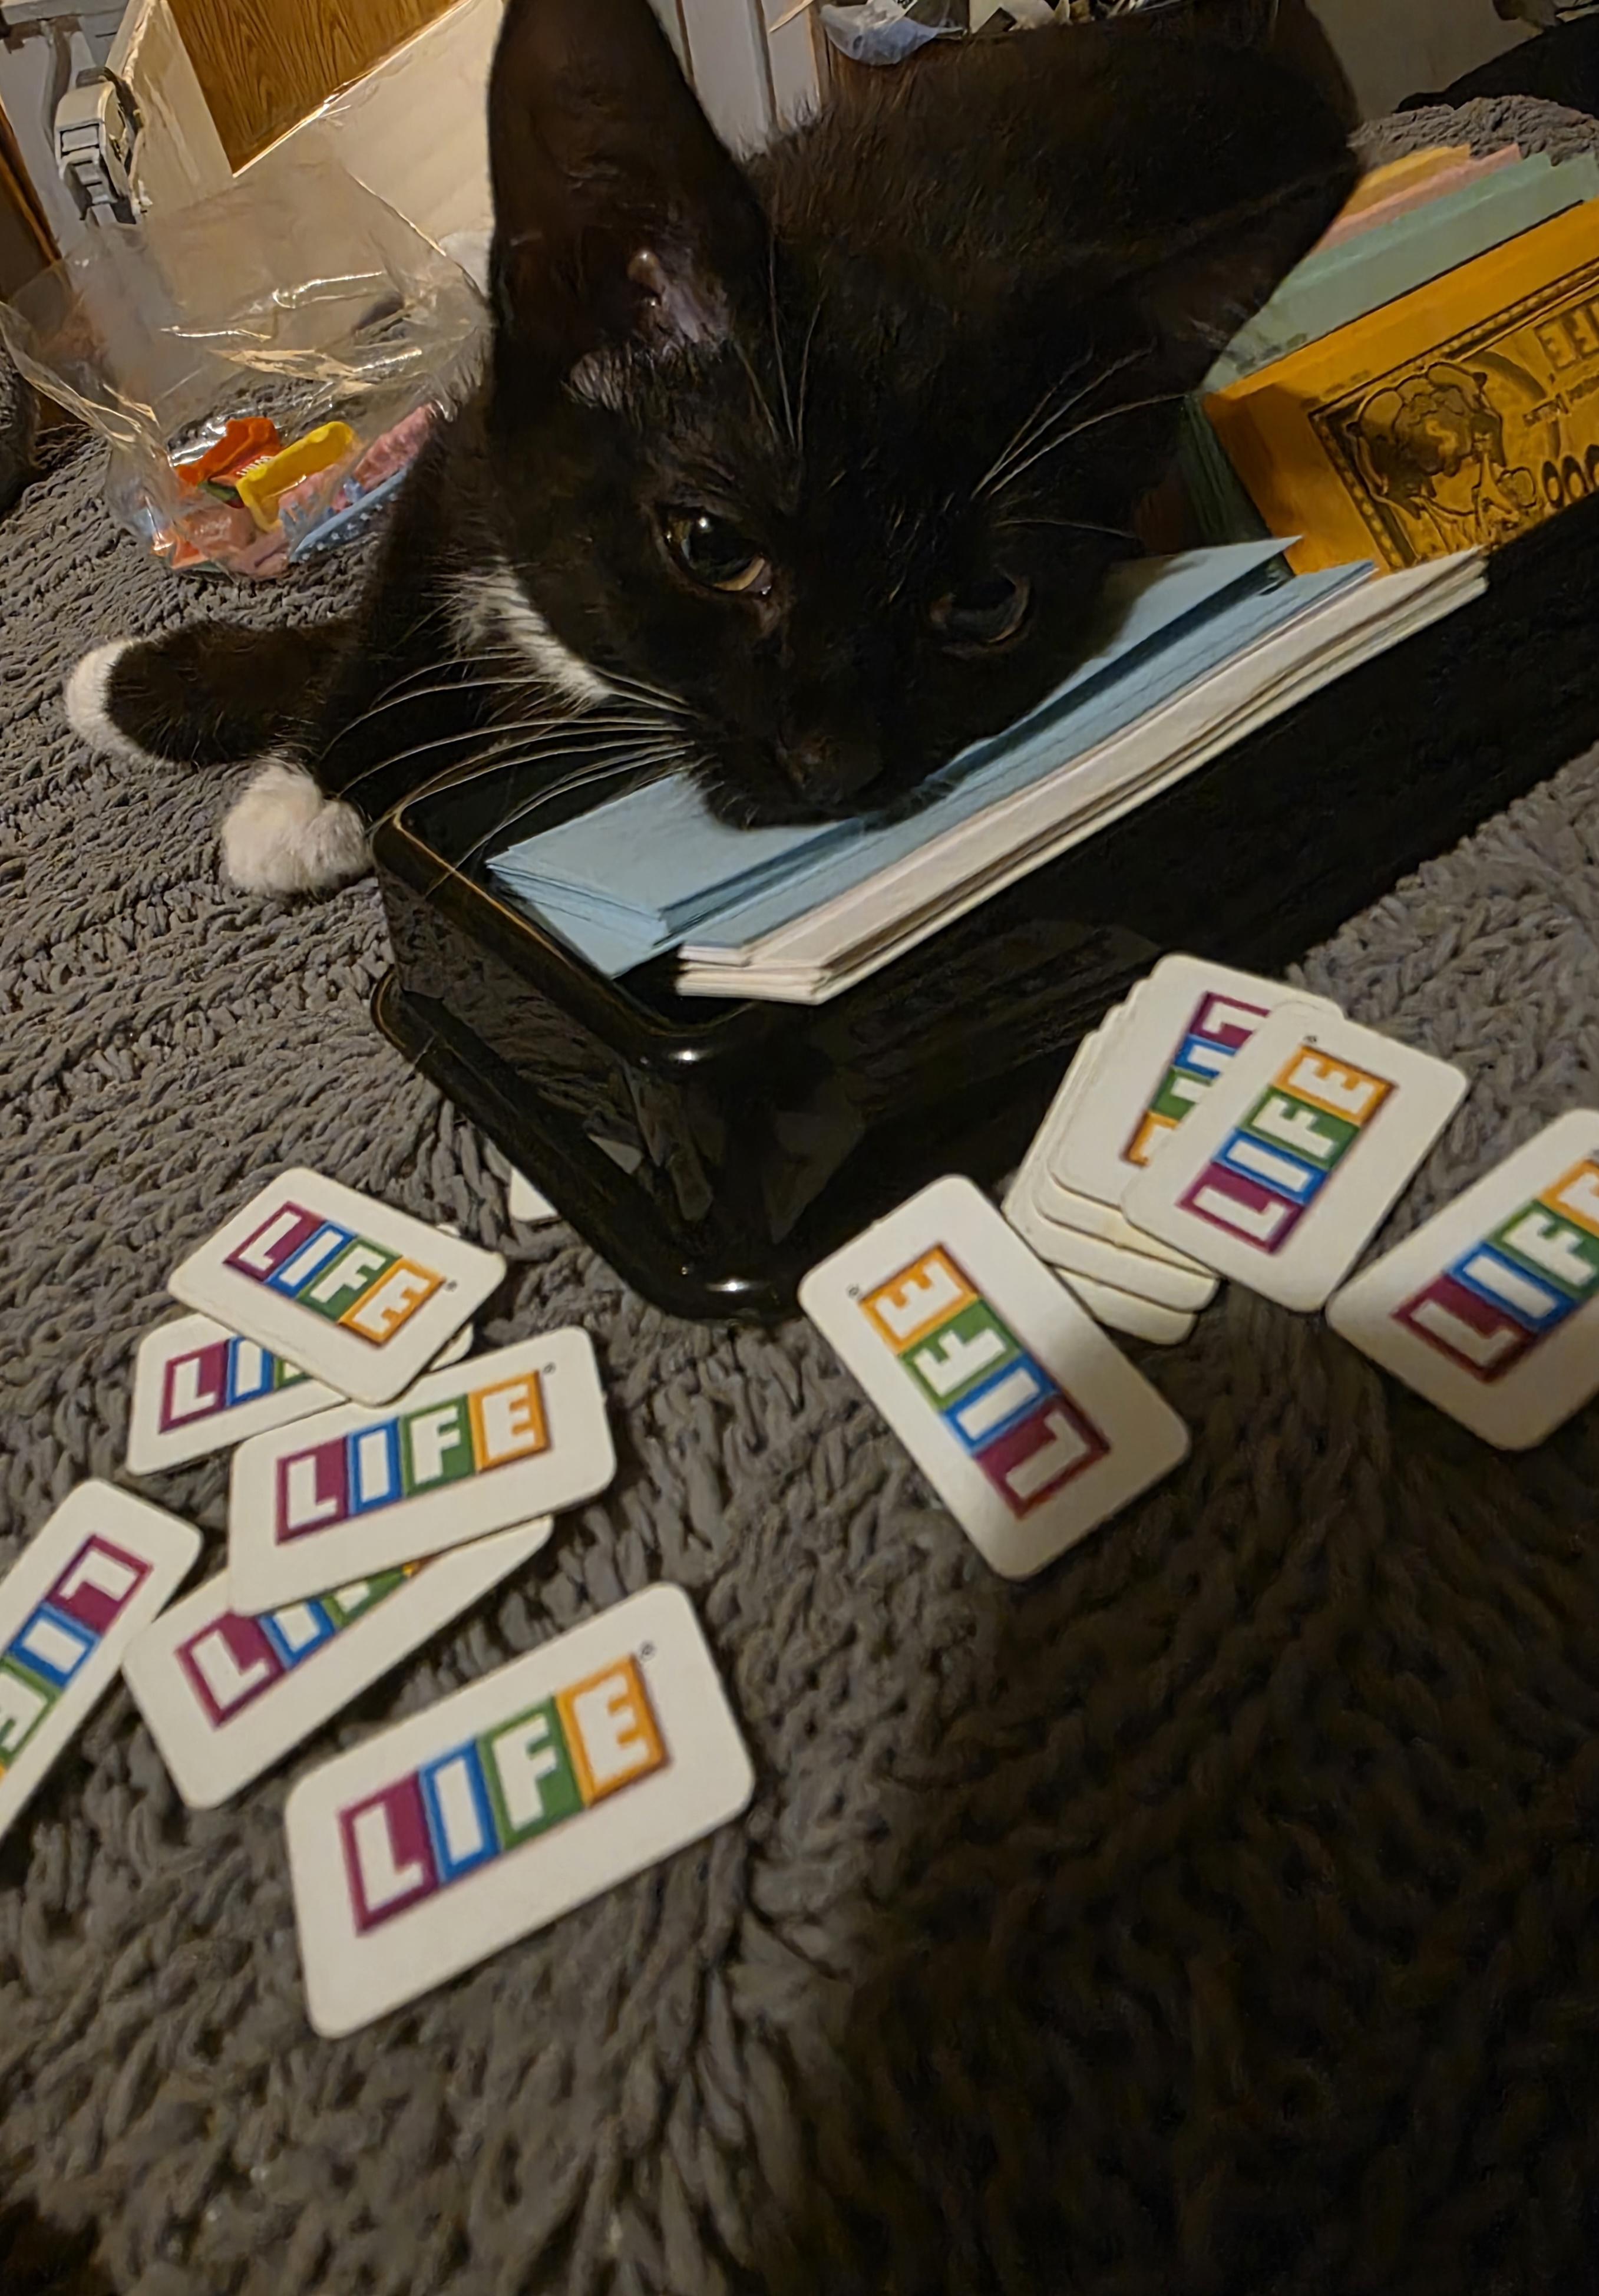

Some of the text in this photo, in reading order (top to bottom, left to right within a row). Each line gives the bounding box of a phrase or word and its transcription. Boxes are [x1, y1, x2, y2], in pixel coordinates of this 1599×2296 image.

[1177, 1045, 1399, 1254] LIFE
[222, 1200, 446, 1350] LIFE
[158, 1335, 312, 1435] LI
[276, 1370, 552, 1545] LIFE
[857, 1242, 1111, 1519] LIFE
[338, 1654, 672, 1936] LIFE
